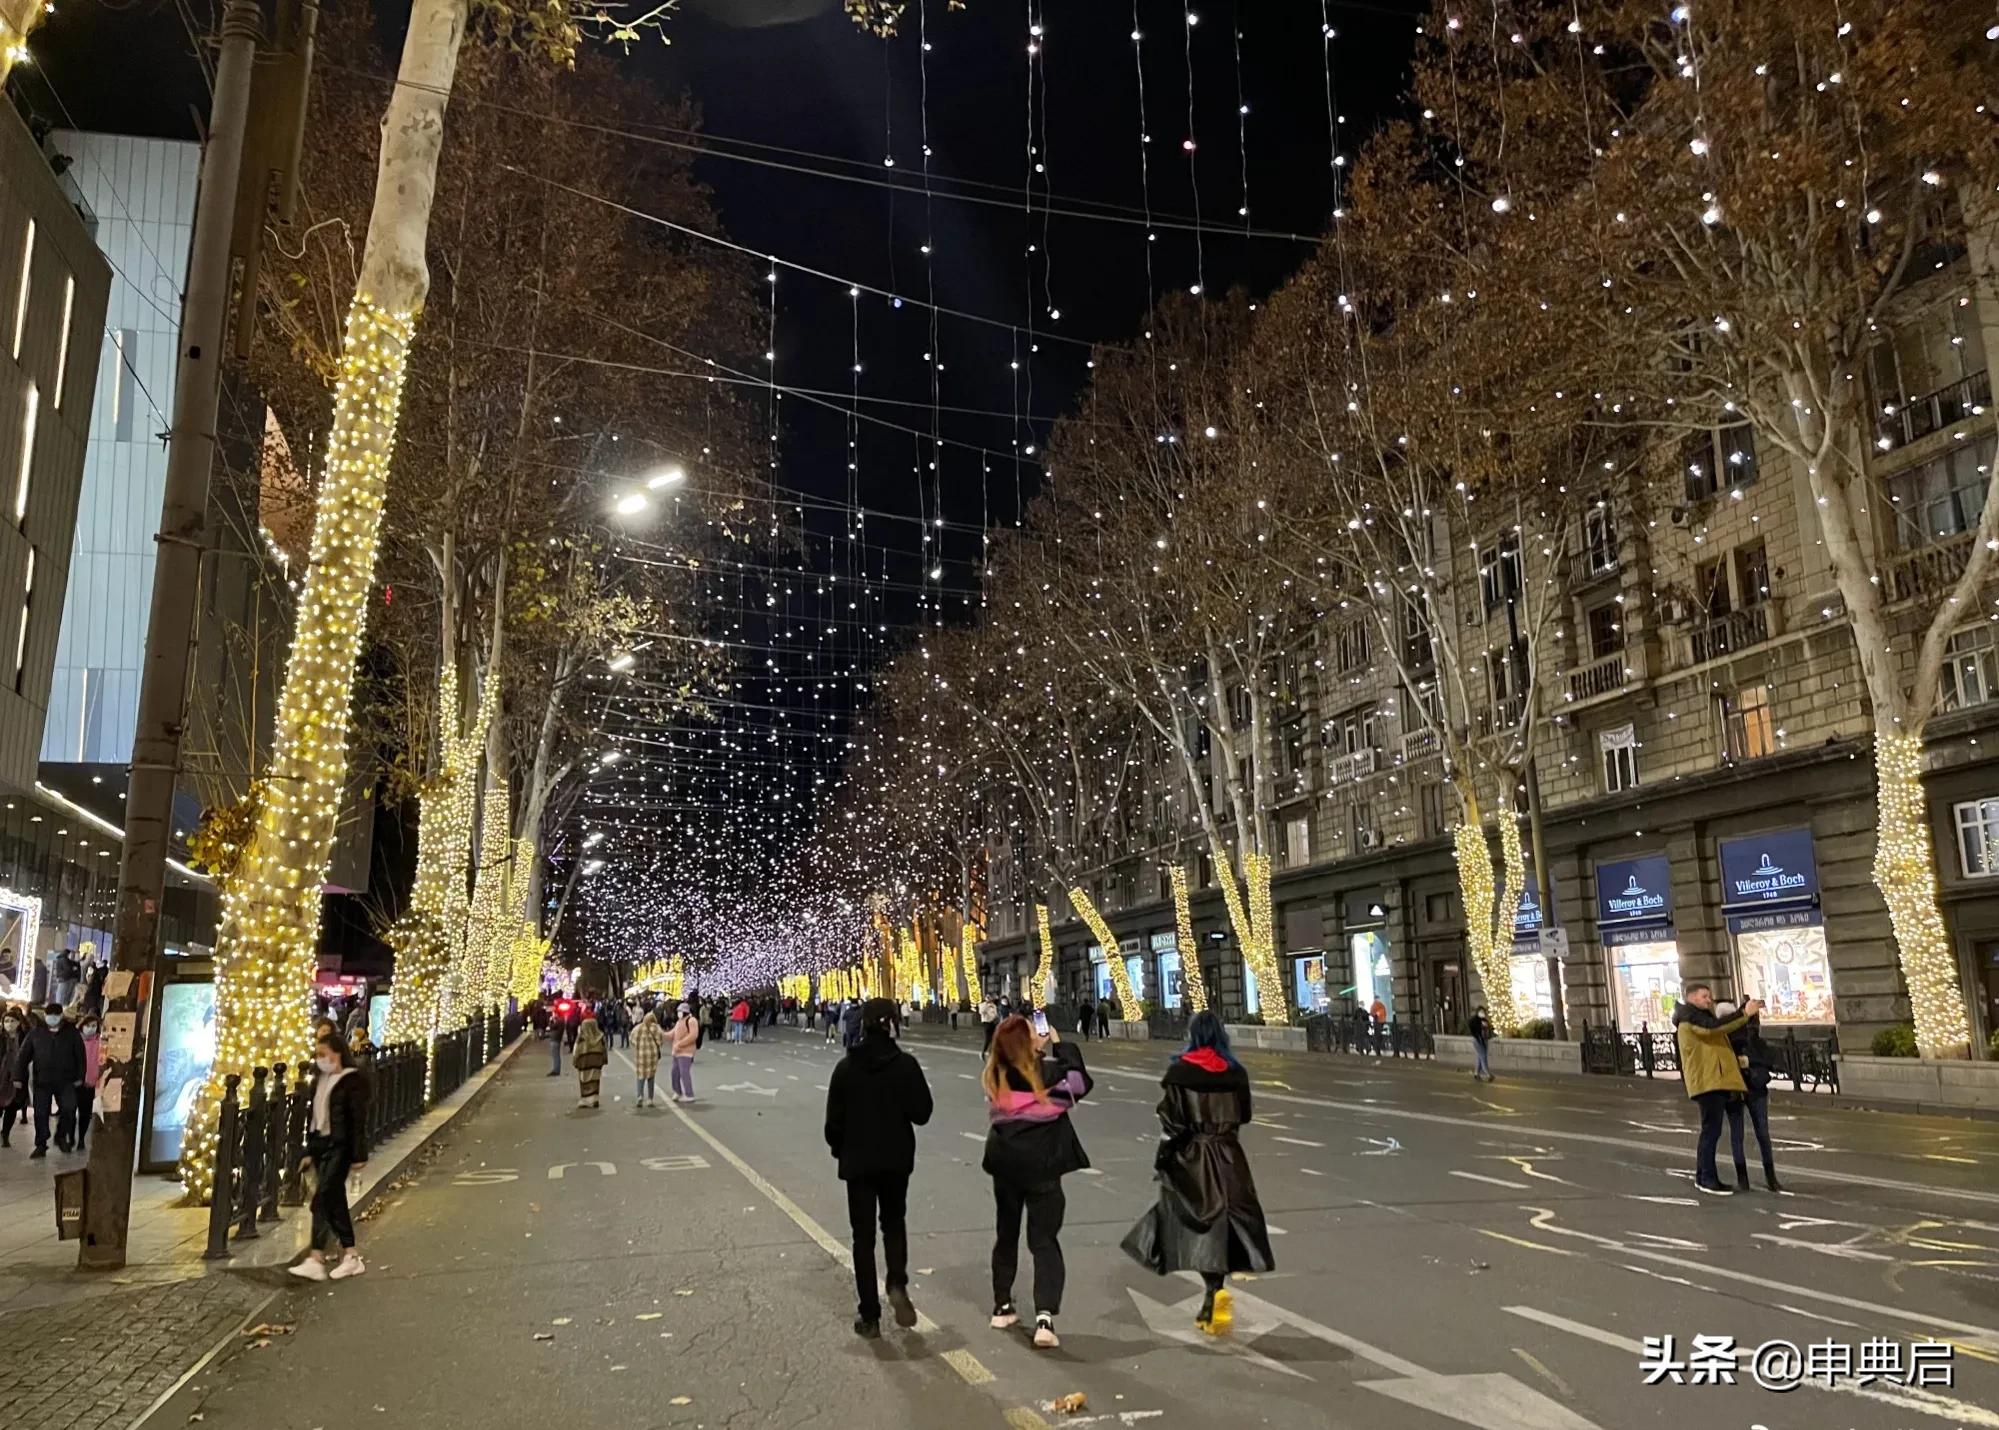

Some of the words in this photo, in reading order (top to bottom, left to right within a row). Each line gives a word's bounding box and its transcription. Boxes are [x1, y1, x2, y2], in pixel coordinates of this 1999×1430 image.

[1735, 878, 1771, 892] Villeroy
[1771, 877, 1778, 887] &
[1779, 873, 1805, 886] Boch
[1608, 898, 1636, 910] Villeroy
[1643, 894, 1663, 906] Boch
[451, 1155, 711, 1185] BUS
